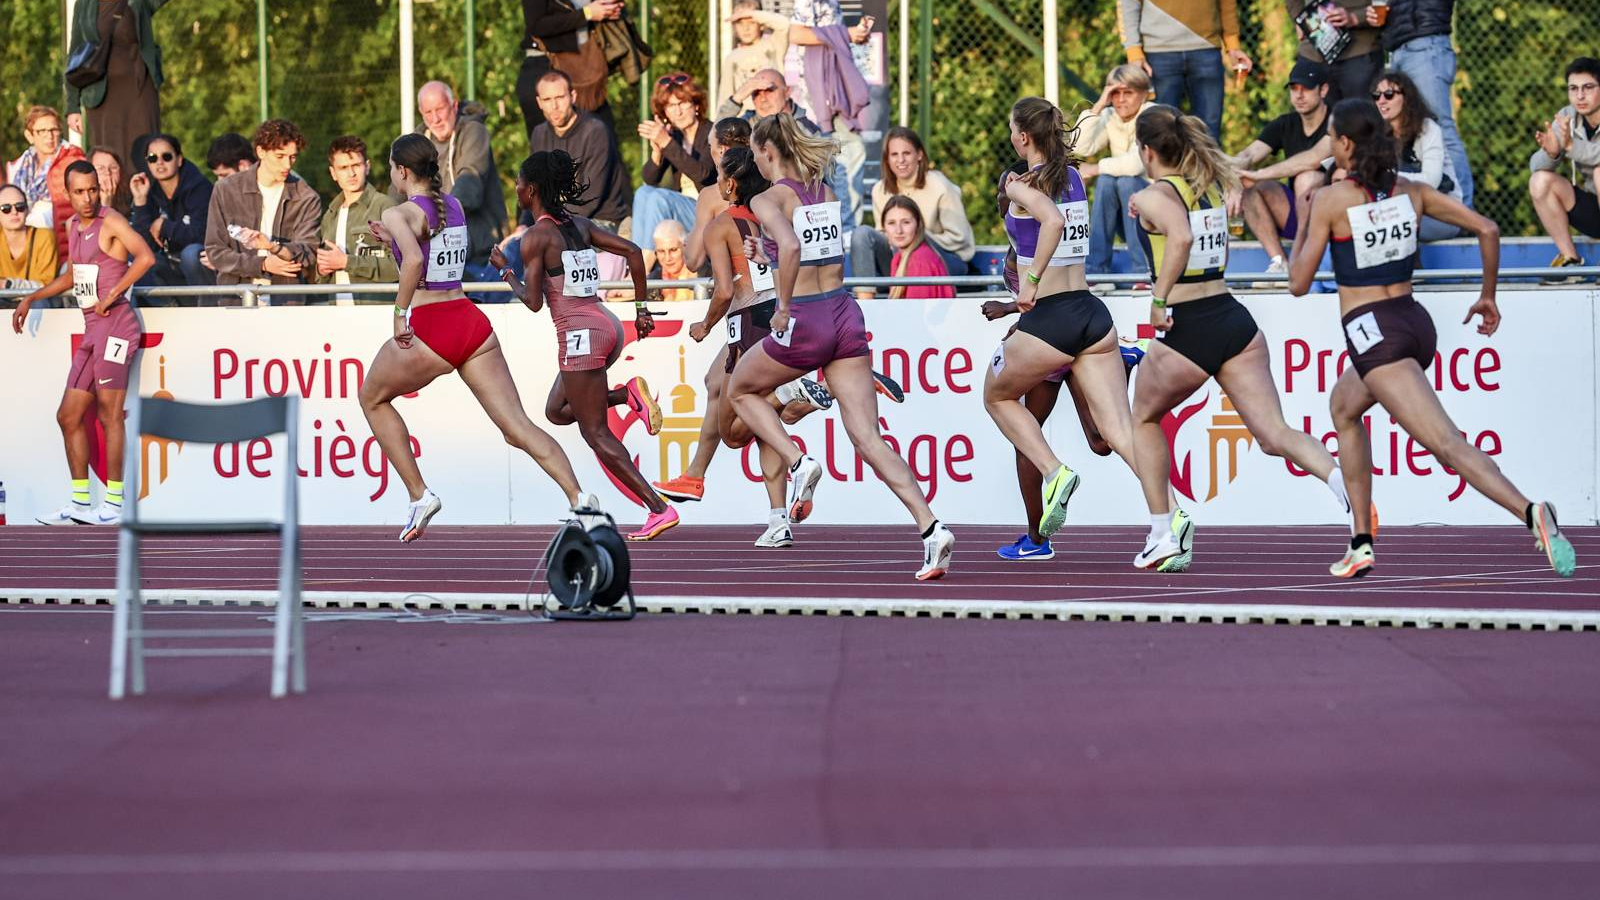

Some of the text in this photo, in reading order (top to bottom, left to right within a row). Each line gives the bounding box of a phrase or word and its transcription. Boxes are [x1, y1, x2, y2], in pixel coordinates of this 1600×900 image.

[802, 224, 838, 244] 9750
[1062, 223, 1089, 242] 1298
[1364, 221, 1412, 249] 9745
[436, 248, 466, 266] 6110
[571, 267, 599, 283] 9749
[729, 321, 736, 339] 6
[1356, 323, 1370, 341] 1
[113, 343, 122, 358] 7
[573, 334, 582, 351] 7
[213, 343, 419, 399] Provin
